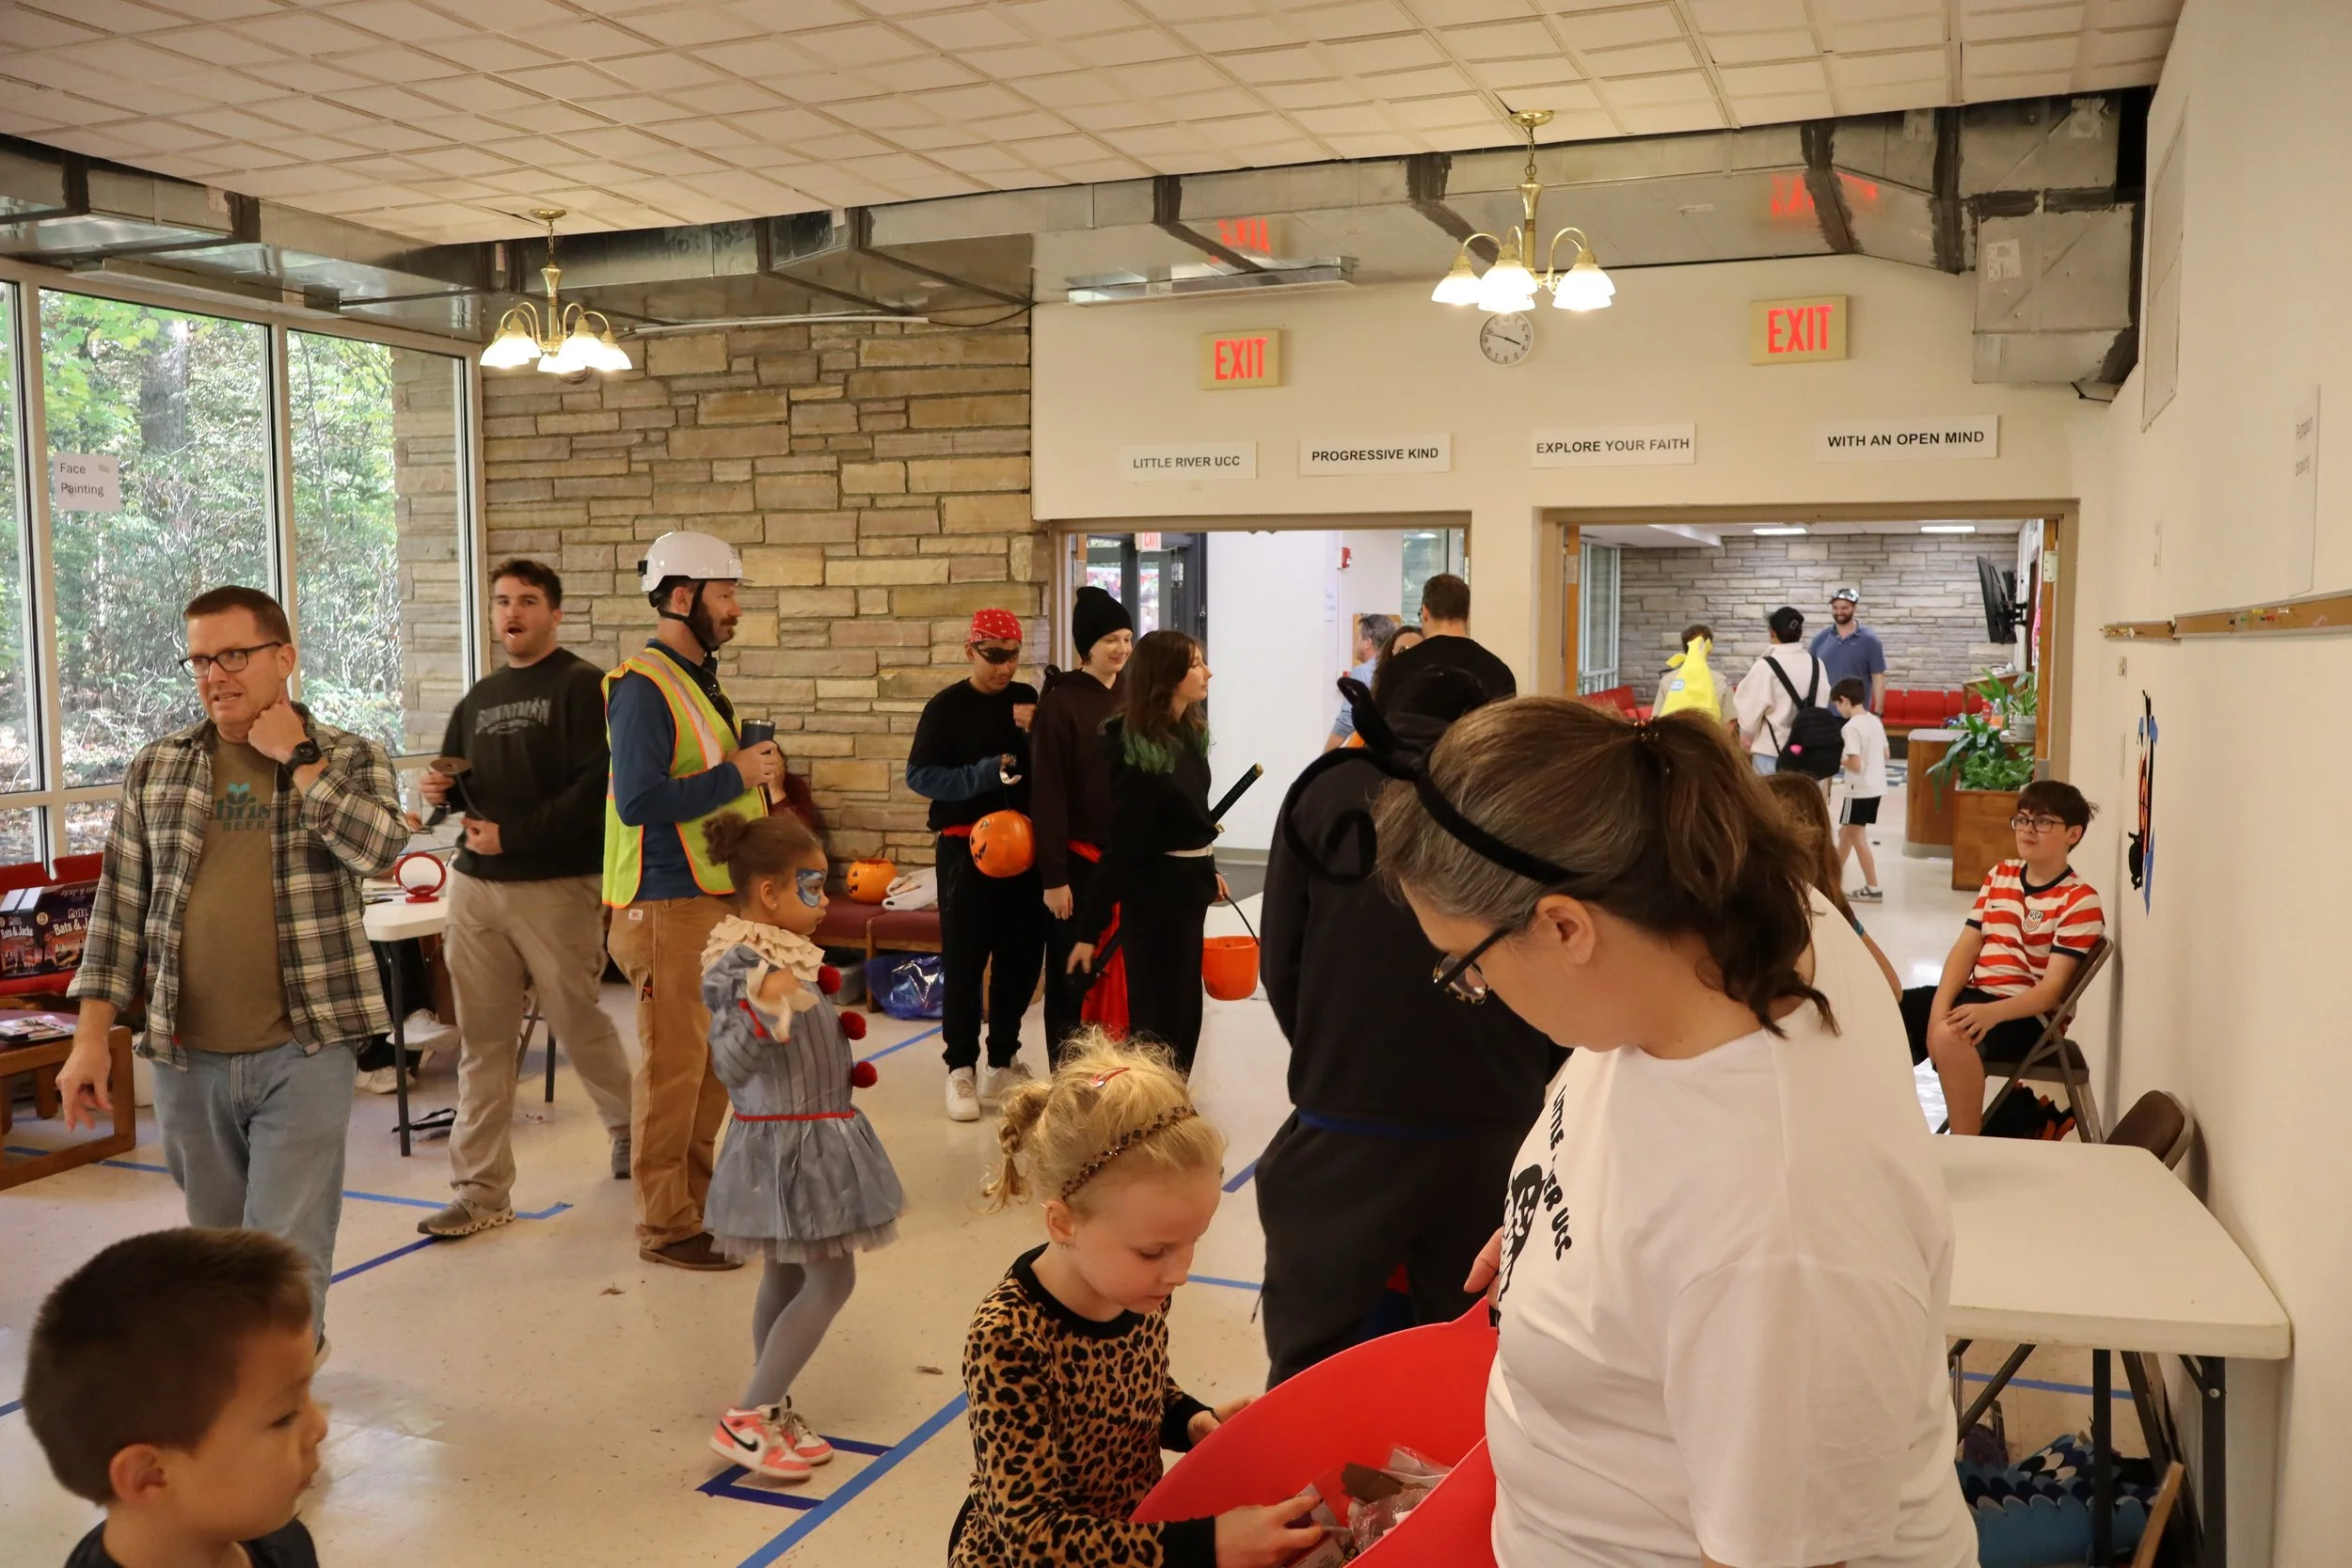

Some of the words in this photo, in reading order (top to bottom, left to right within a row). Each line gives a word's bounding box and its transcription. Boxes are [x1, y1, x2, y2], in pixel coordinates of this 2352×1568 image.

[1768, 304, 1834, 354] EXIT
[1215, 337, 1268, 380] EXIT
[1536, 441, 1601, 453] EXPLORE
[1605, 439, 1645, 451] YOUR
[1649, 438, 1691, 451] FAITH
[1827, 436, 1867, 448] WITH
[1870, 435, 1892, 446] AN
[1897, 433, 1940, 445] OPEN
[1945, 431, 1984, 444] MIND
[1133, 457, 1172, 468] LITTLE
[1175, 456, 1212, 467] RIVER
[1215, 455, 1241, 467] UCC
[1311, 449, 1404, 461] PROGRESSIVE
[1408, 448, 1439, 459] KIND
[59, 462, 87, 474] Face
[60, 482, 104, 498] Painting
[2030, 911, 2042, 920] USA
[53, 921, 72, 936] Bats
[73, 918, 83, 931] &
[1551, 1207, 1572, 1261] UCC
